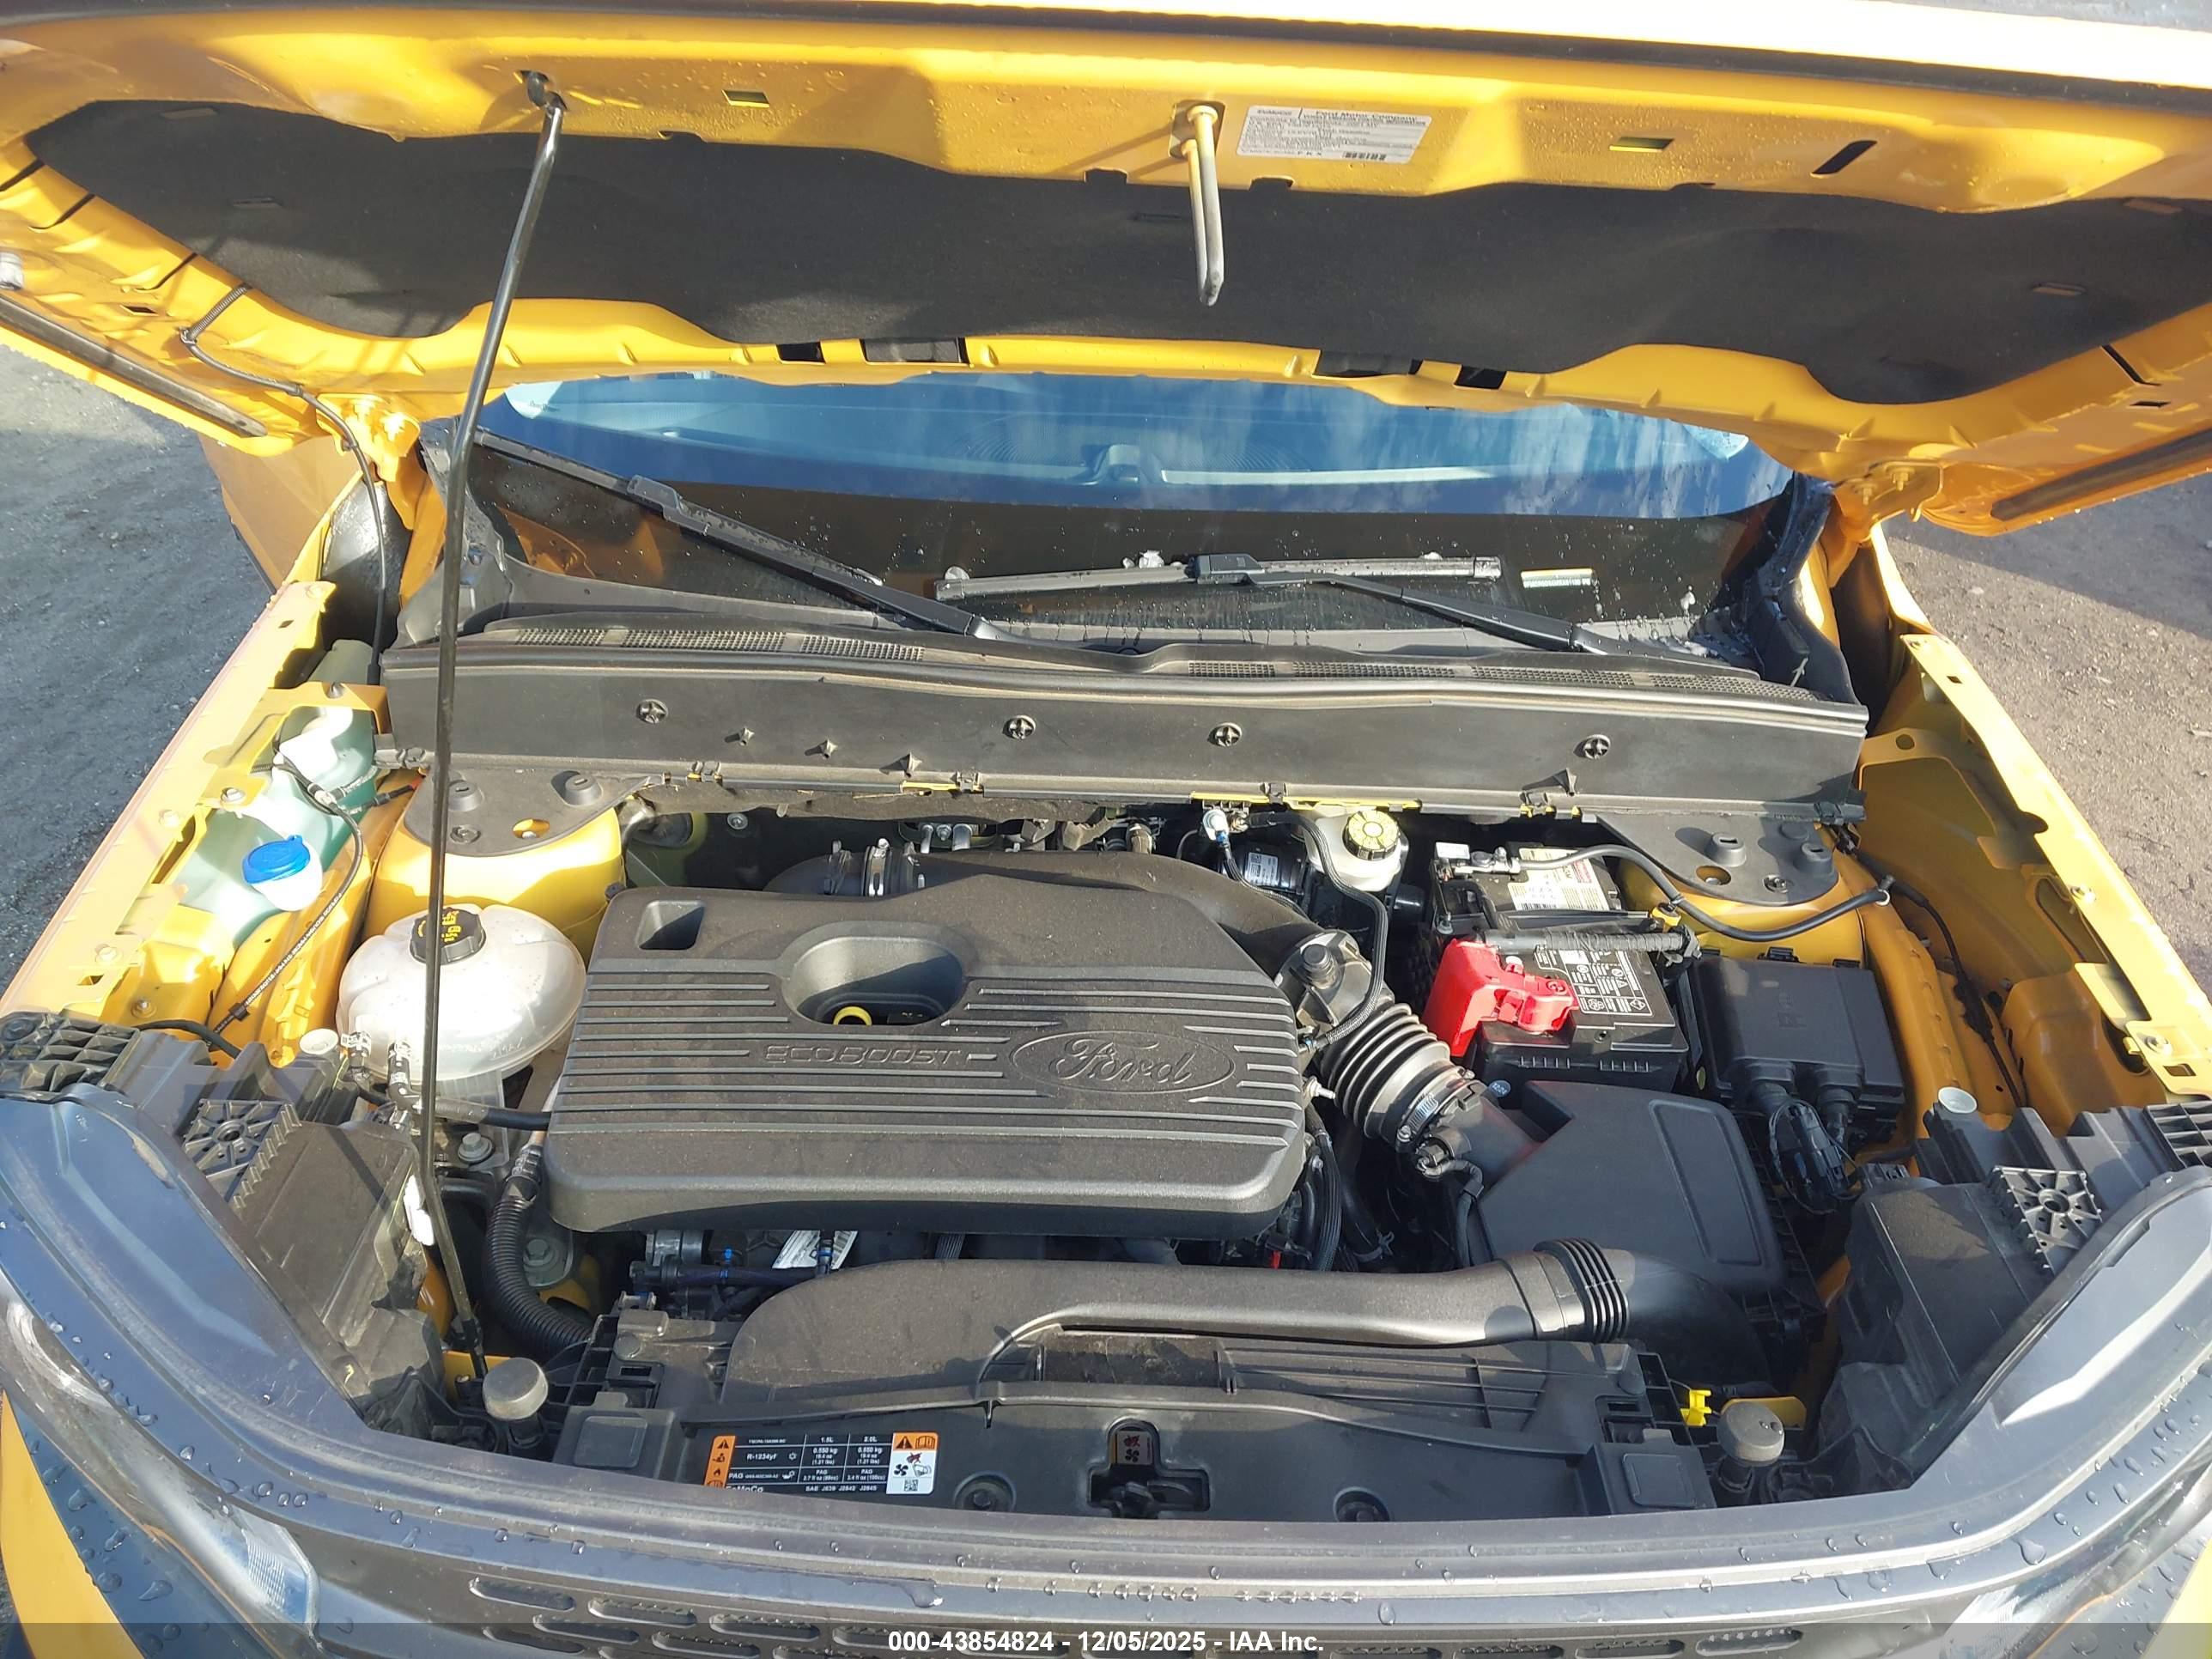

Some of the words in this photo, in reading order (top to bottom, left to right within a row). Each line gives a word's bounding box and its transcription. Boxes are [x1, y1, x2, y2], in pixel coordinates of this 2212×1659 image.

[1048, 1037, 1197, 1085] Ford
[830, 1447, 838, 1455] kg
[874, 1447, 883, 1455] kg
[746, 1452, 777, 1461] R-1234yf
